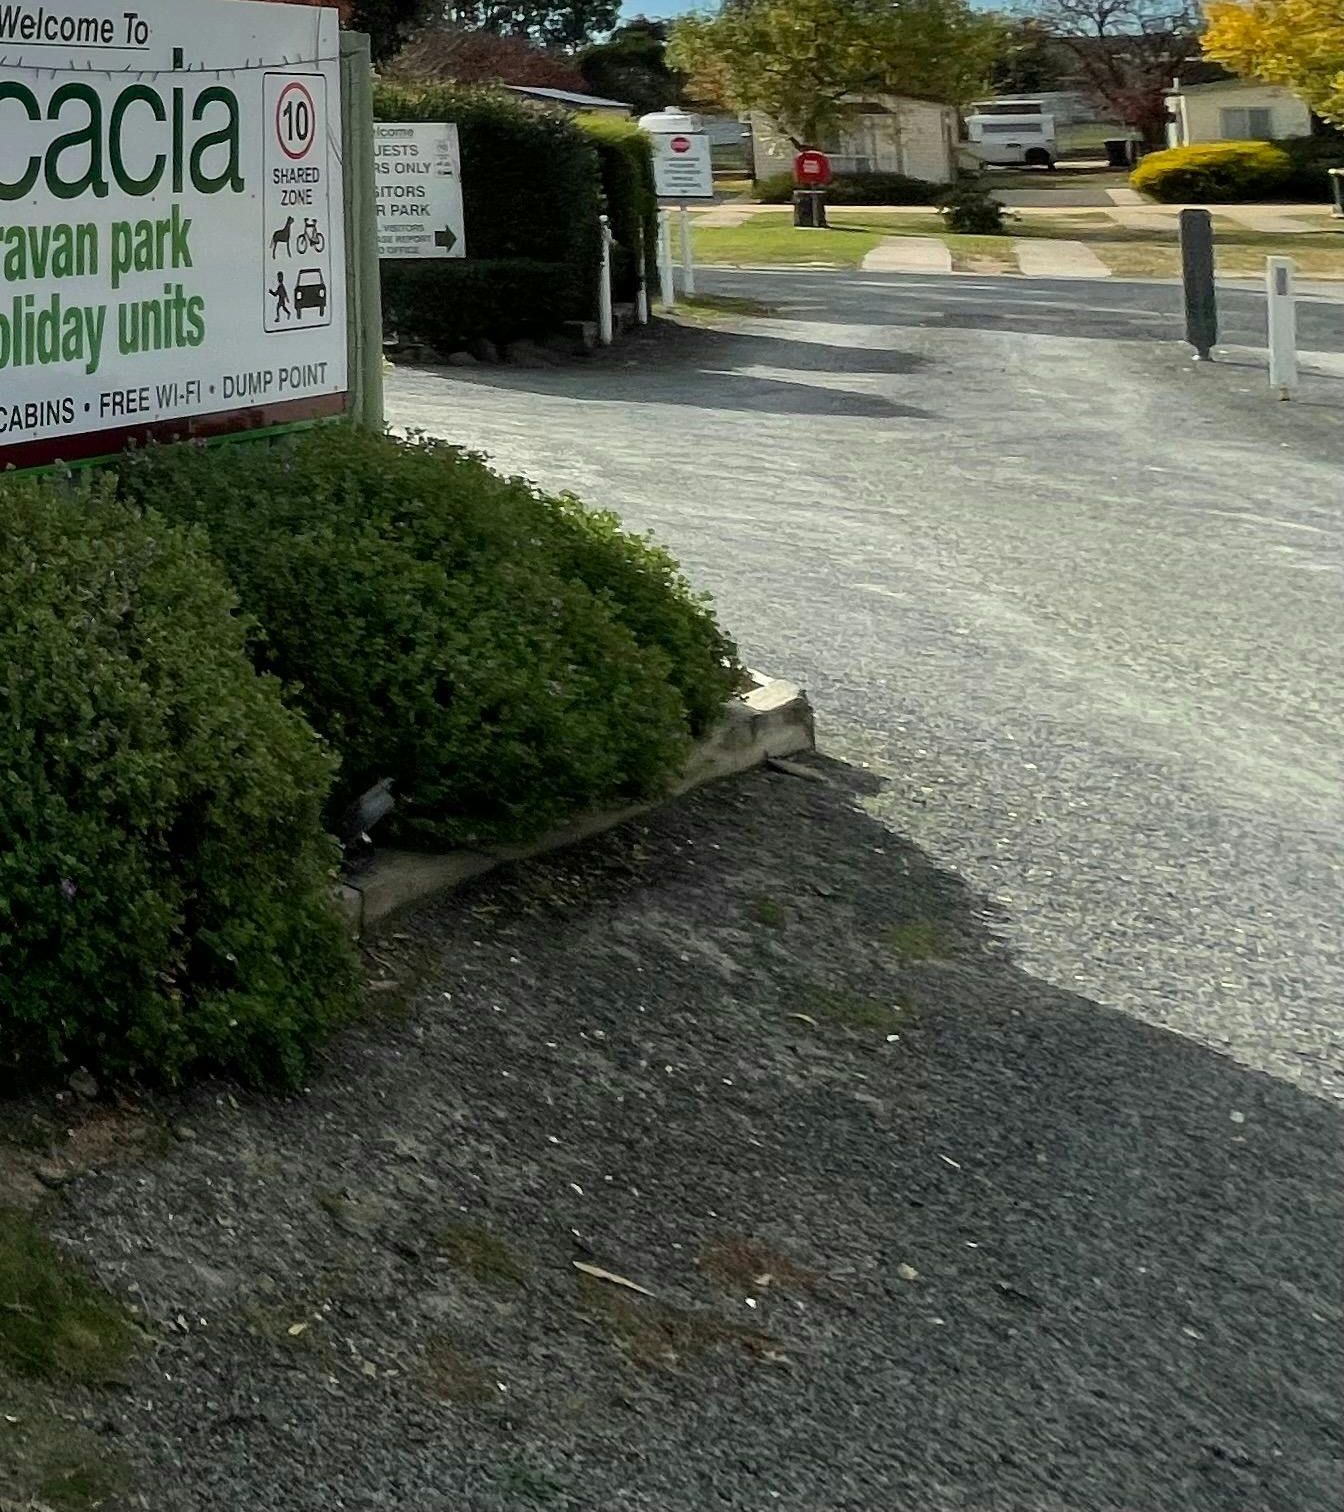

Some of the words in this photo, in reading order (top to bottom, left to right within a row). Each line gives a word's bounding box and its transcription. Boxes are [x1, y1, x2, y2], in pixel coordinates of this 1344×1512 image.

[124, 12, 149, 45] To
[283, 100, 309, 141] 10
[374, 144, 419, 157] UESTS
[273, 167, 320, 184] SHARED
[394, 162, 432, 174] ONLY
[281, 189, 313, 206] ZONE
[390, 204, 431, 216] PARK
[112, 204, 192, 288] park
[118, 282, 205, 356] units
[100, 387, 150, 419] FREE
[156, 380, 201, 410] WI-FI
[223, 370, 274, 400] DUMP
[278, 362, 328, 390] POINT
